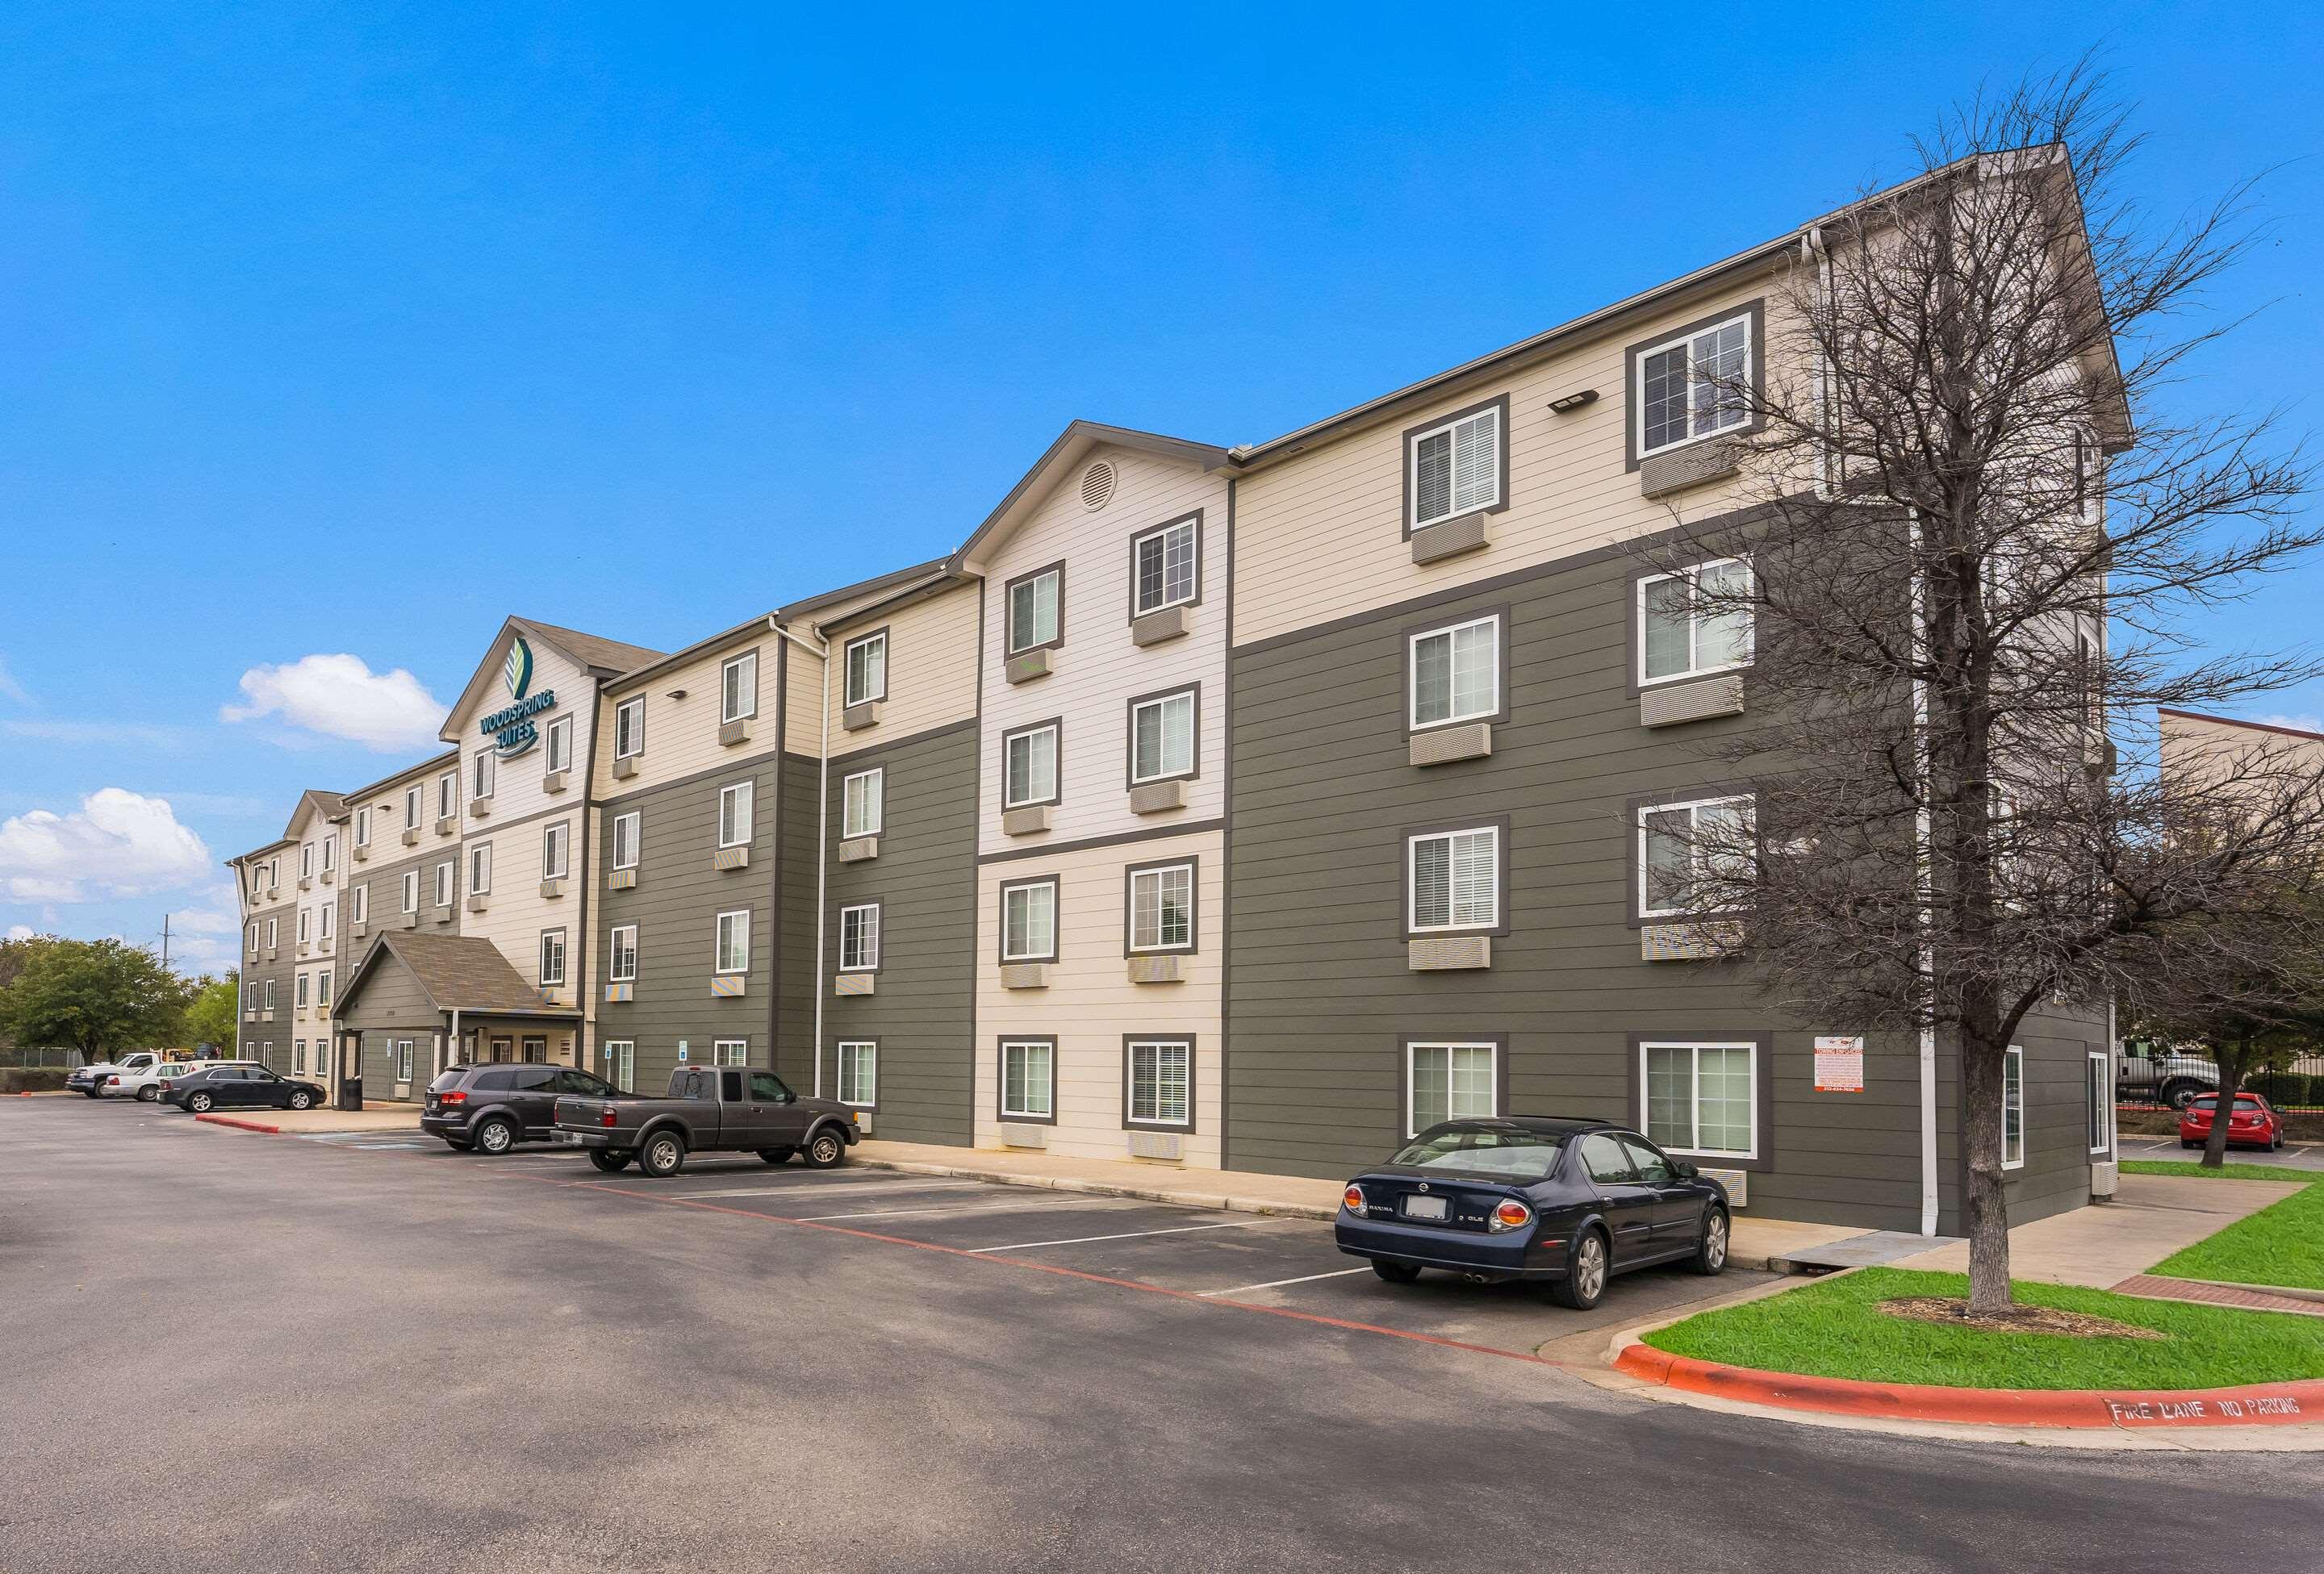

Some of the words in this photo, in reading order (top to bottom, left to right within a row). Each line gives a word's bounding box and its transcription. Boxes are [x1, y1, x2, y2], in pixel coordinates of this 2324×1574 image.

[479, 689, 555, 735] WOODSPRING
[495, 720, 535, 749] SUITES
[2110, 1402, 2154, 1420] FIRE
[2158, 1401, 2207, 1419] LANE
[2217, 1401, 2242, 1417] NO
[2243, 1397, 2300, 1415] PARKING
